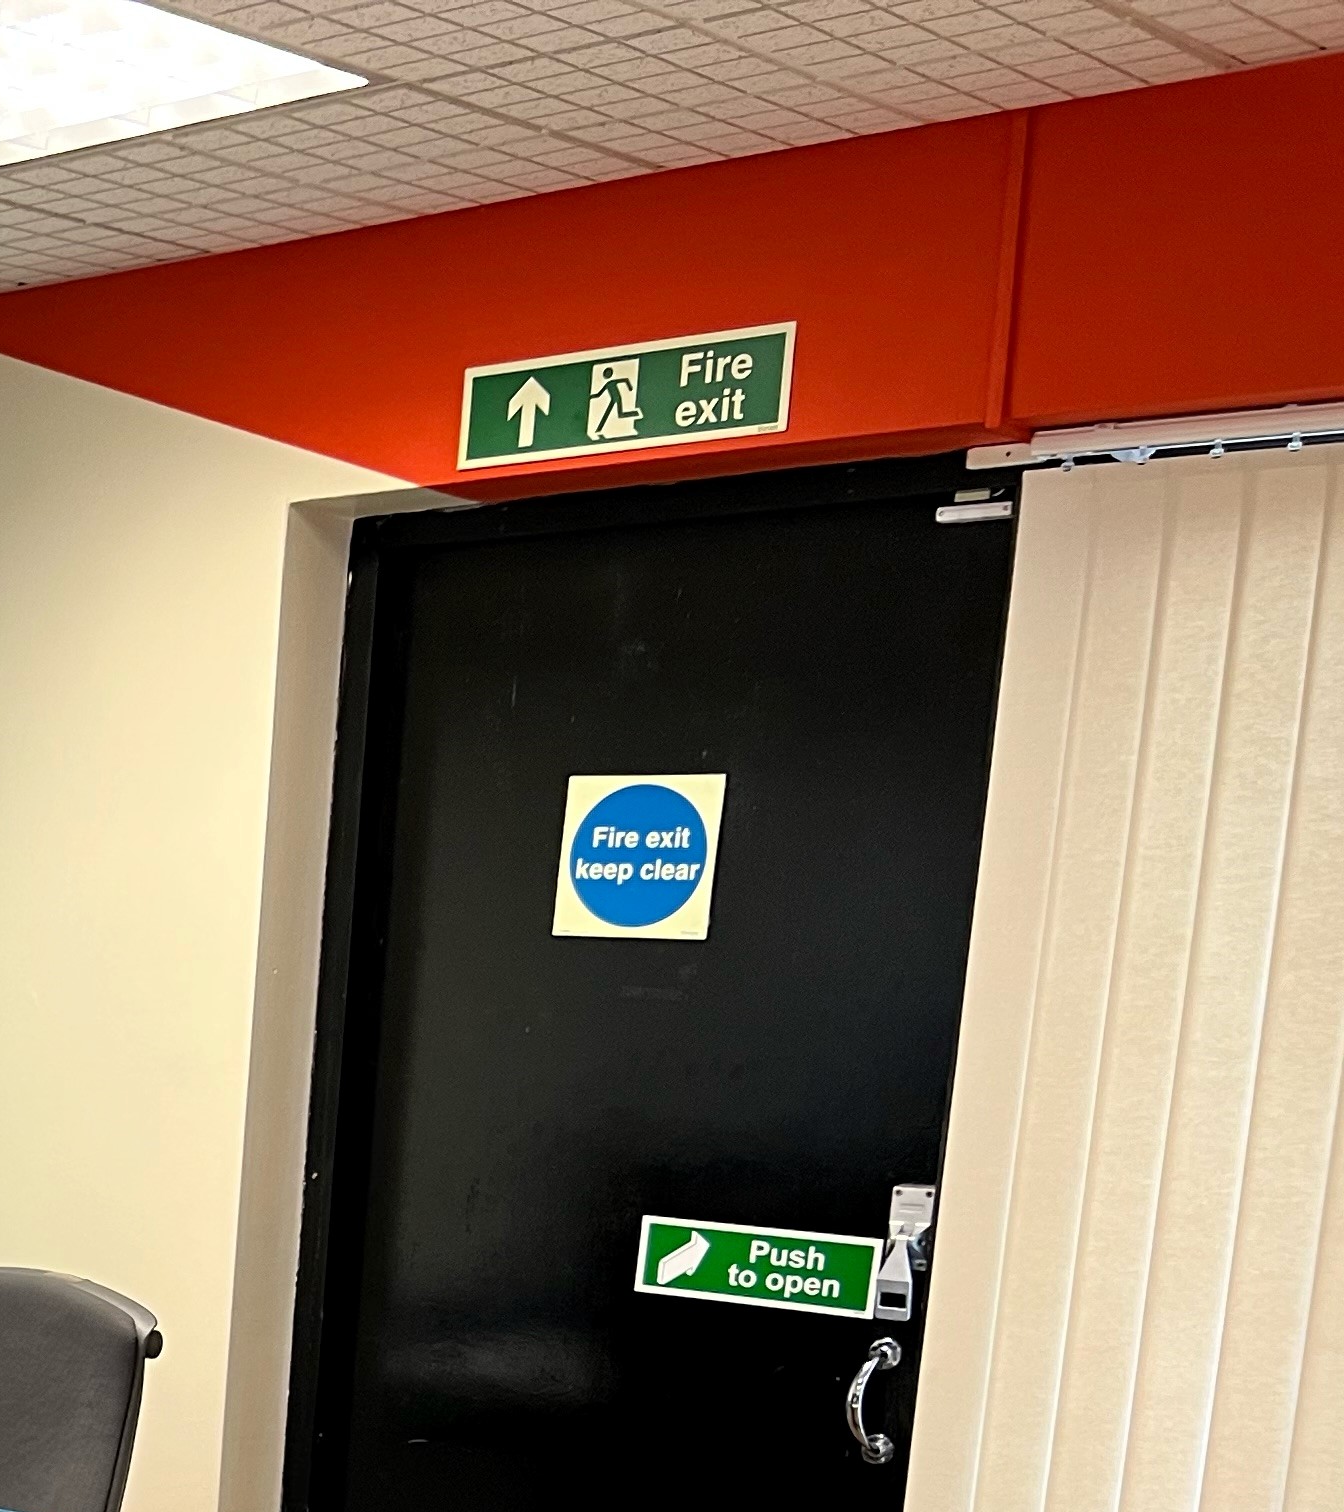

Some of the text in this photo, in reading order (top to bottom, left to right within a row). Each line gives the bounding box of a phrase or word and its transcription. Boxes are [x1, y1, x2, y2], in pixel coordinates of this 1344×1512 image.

[679, 350, 753, 388] Fire
[674, 388, 746, 428] exit
[591, 826, 691, 849] Fire exit
[575, 857, 701, 886] keep clear
[748, 1239, 825, 1272] Push
[727, 1263, 840, 1299] to open
